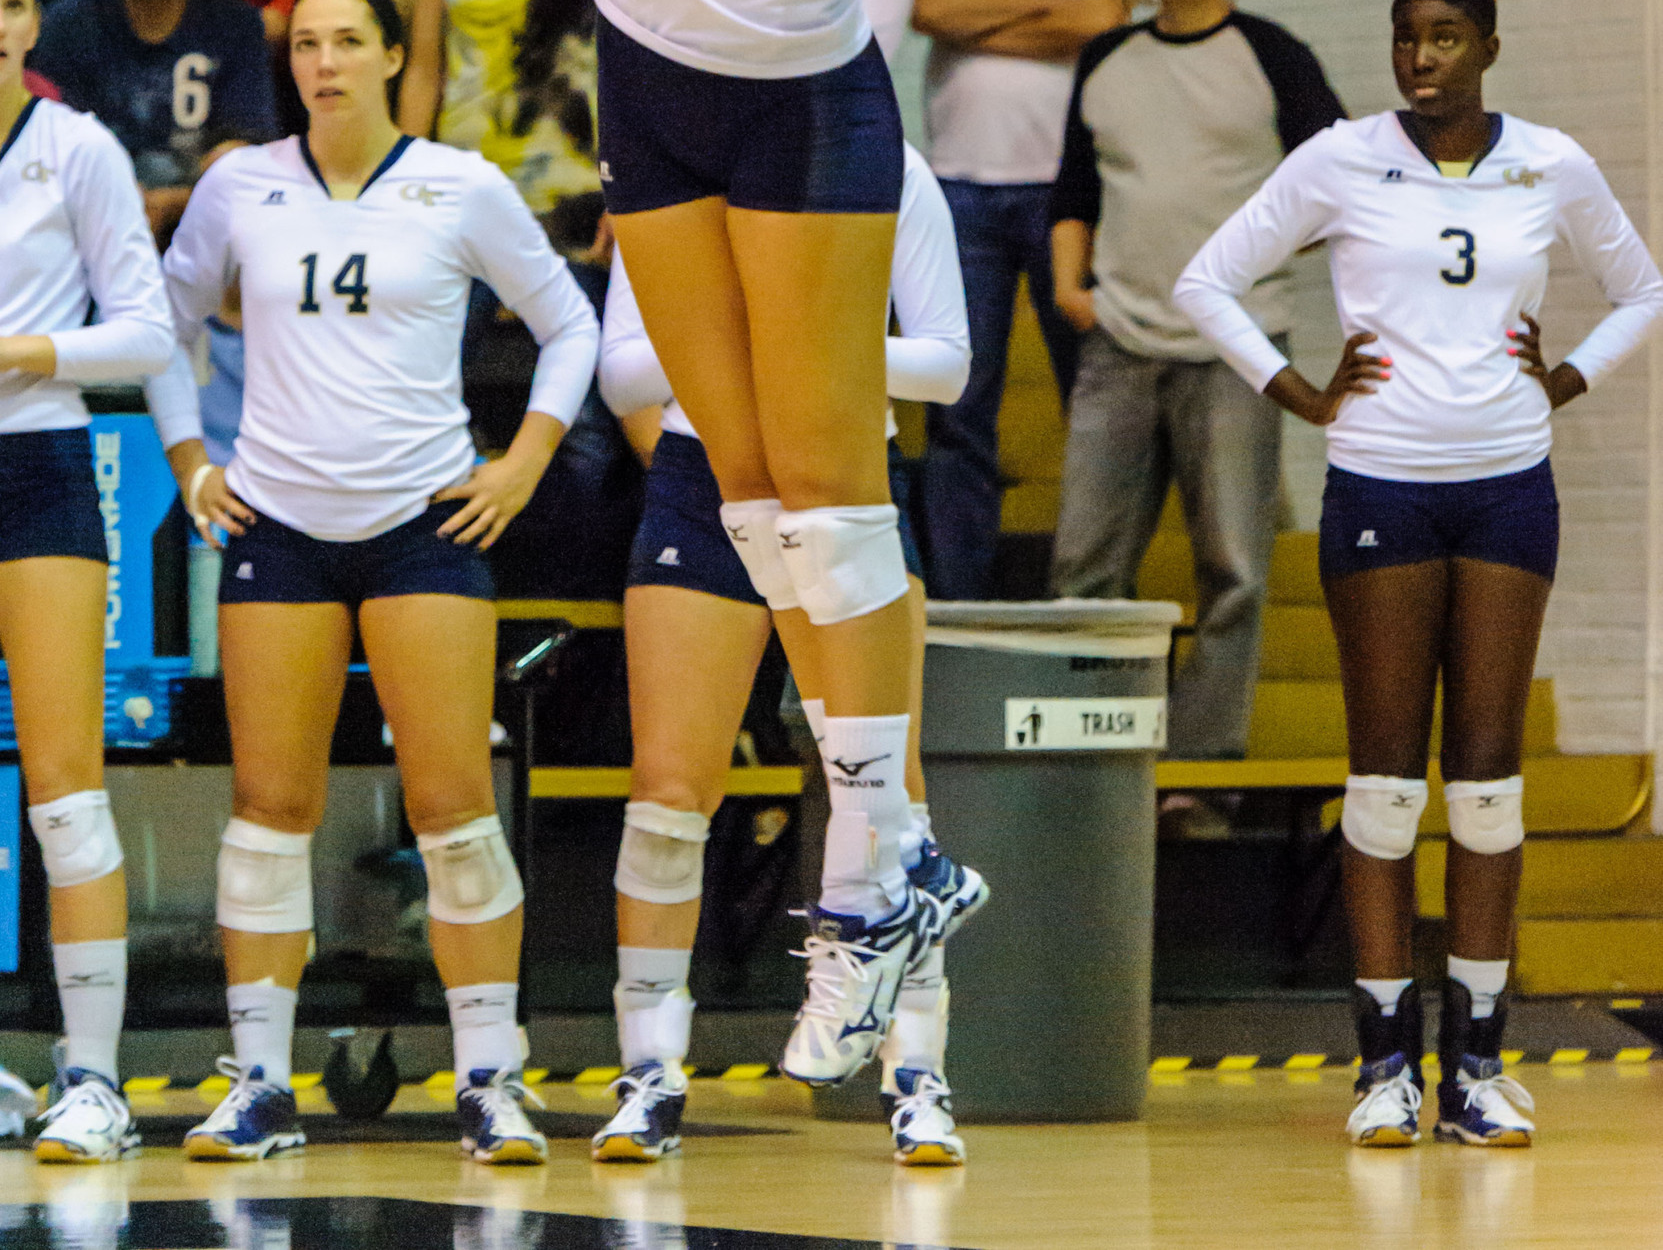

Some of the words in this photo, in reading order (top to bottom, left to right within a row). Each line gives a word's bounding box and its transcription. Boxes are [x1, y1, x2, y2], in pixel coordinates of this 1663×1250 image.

[172, 51, 212, 129] 6
[298, 252, 370, 316] 14
[1440, 226, 1478, 287] 3
[1080, 711, 1136, 736] TRASH
